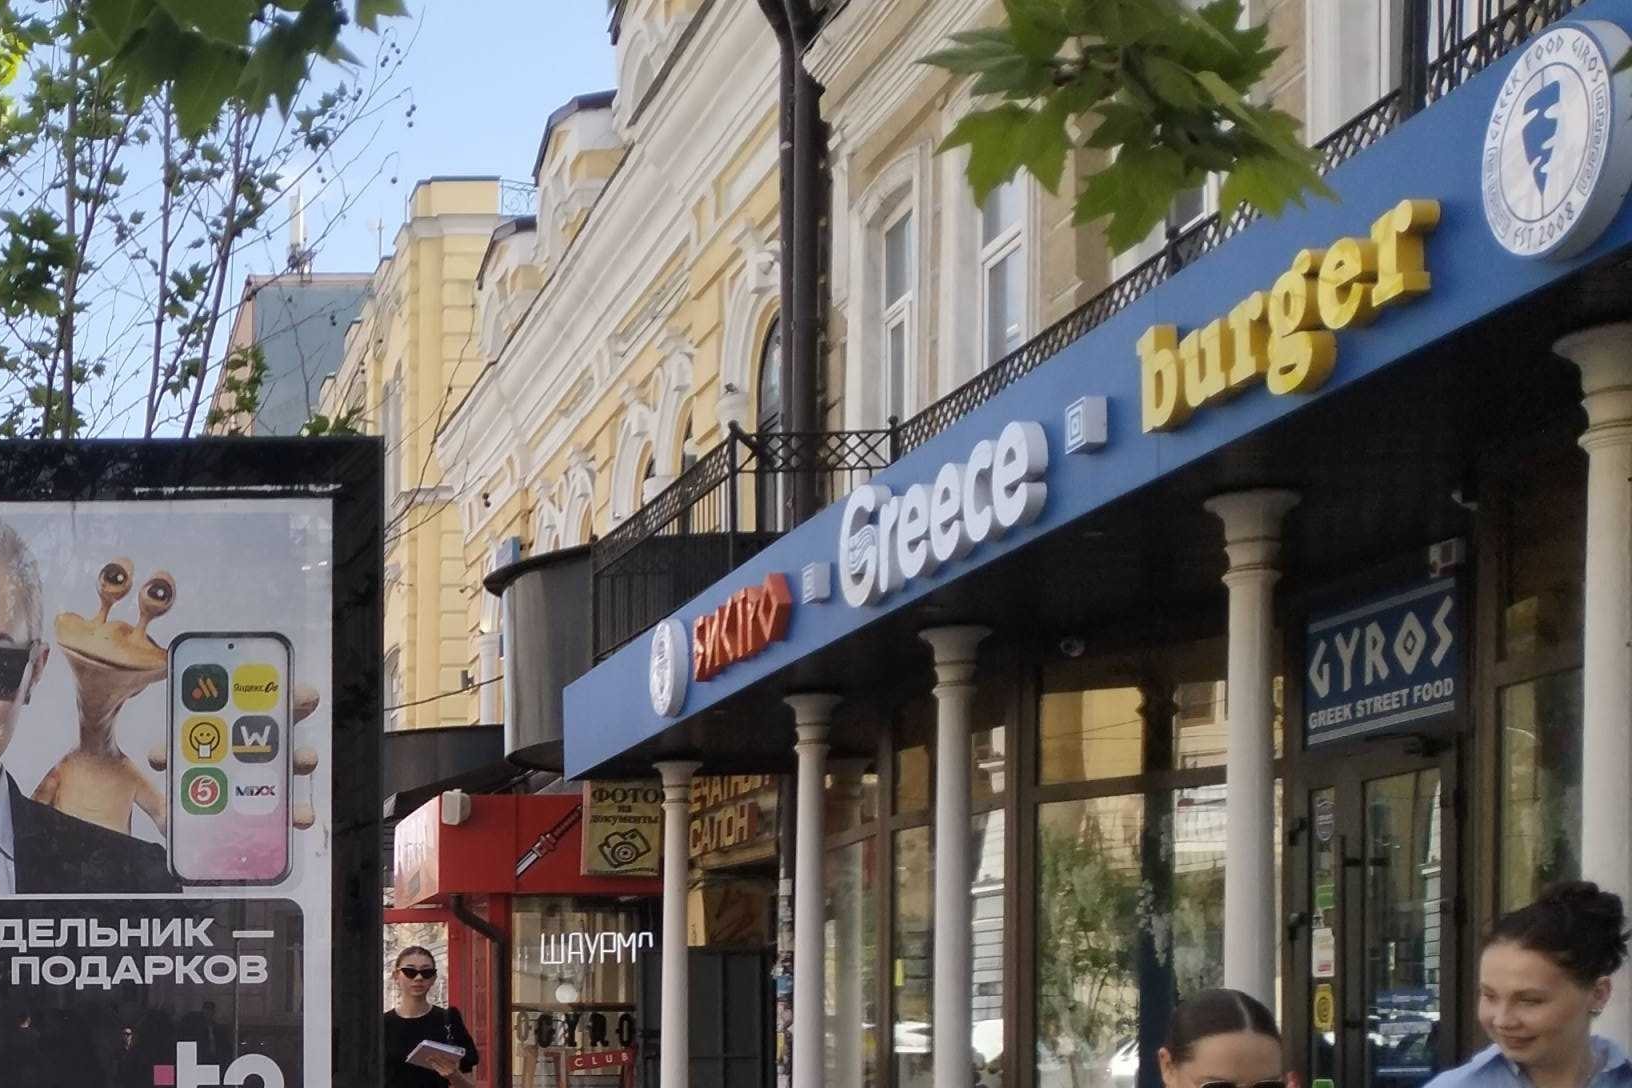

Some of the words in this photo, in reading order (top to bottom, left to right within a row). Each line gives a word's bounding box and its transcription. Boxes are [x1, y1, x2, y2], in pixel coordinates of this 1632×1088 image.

[1489, 67, 1521, 141] GREEK
[1523, 34, 1565, 71] FOOD
[1136, 198, 1439, 434] burger
[839, 419, 1048, 608] Greece
[692, 572, 790, 683] БИСТРО
[1308, 594, 1455, 699] GYROS
[1307, 703, 1353, 730] GREEK
[1356, 688, 1410, 717] STREET
[1413, 677, 1455, 704] FOOD
[592, 787, 658, 804] ФОТО
[689, 801, 752, 857] САЛОН
[11, 955, 269, 990] ПОДАРКОВ
[574, 1052, 630, 1068] CLUB
